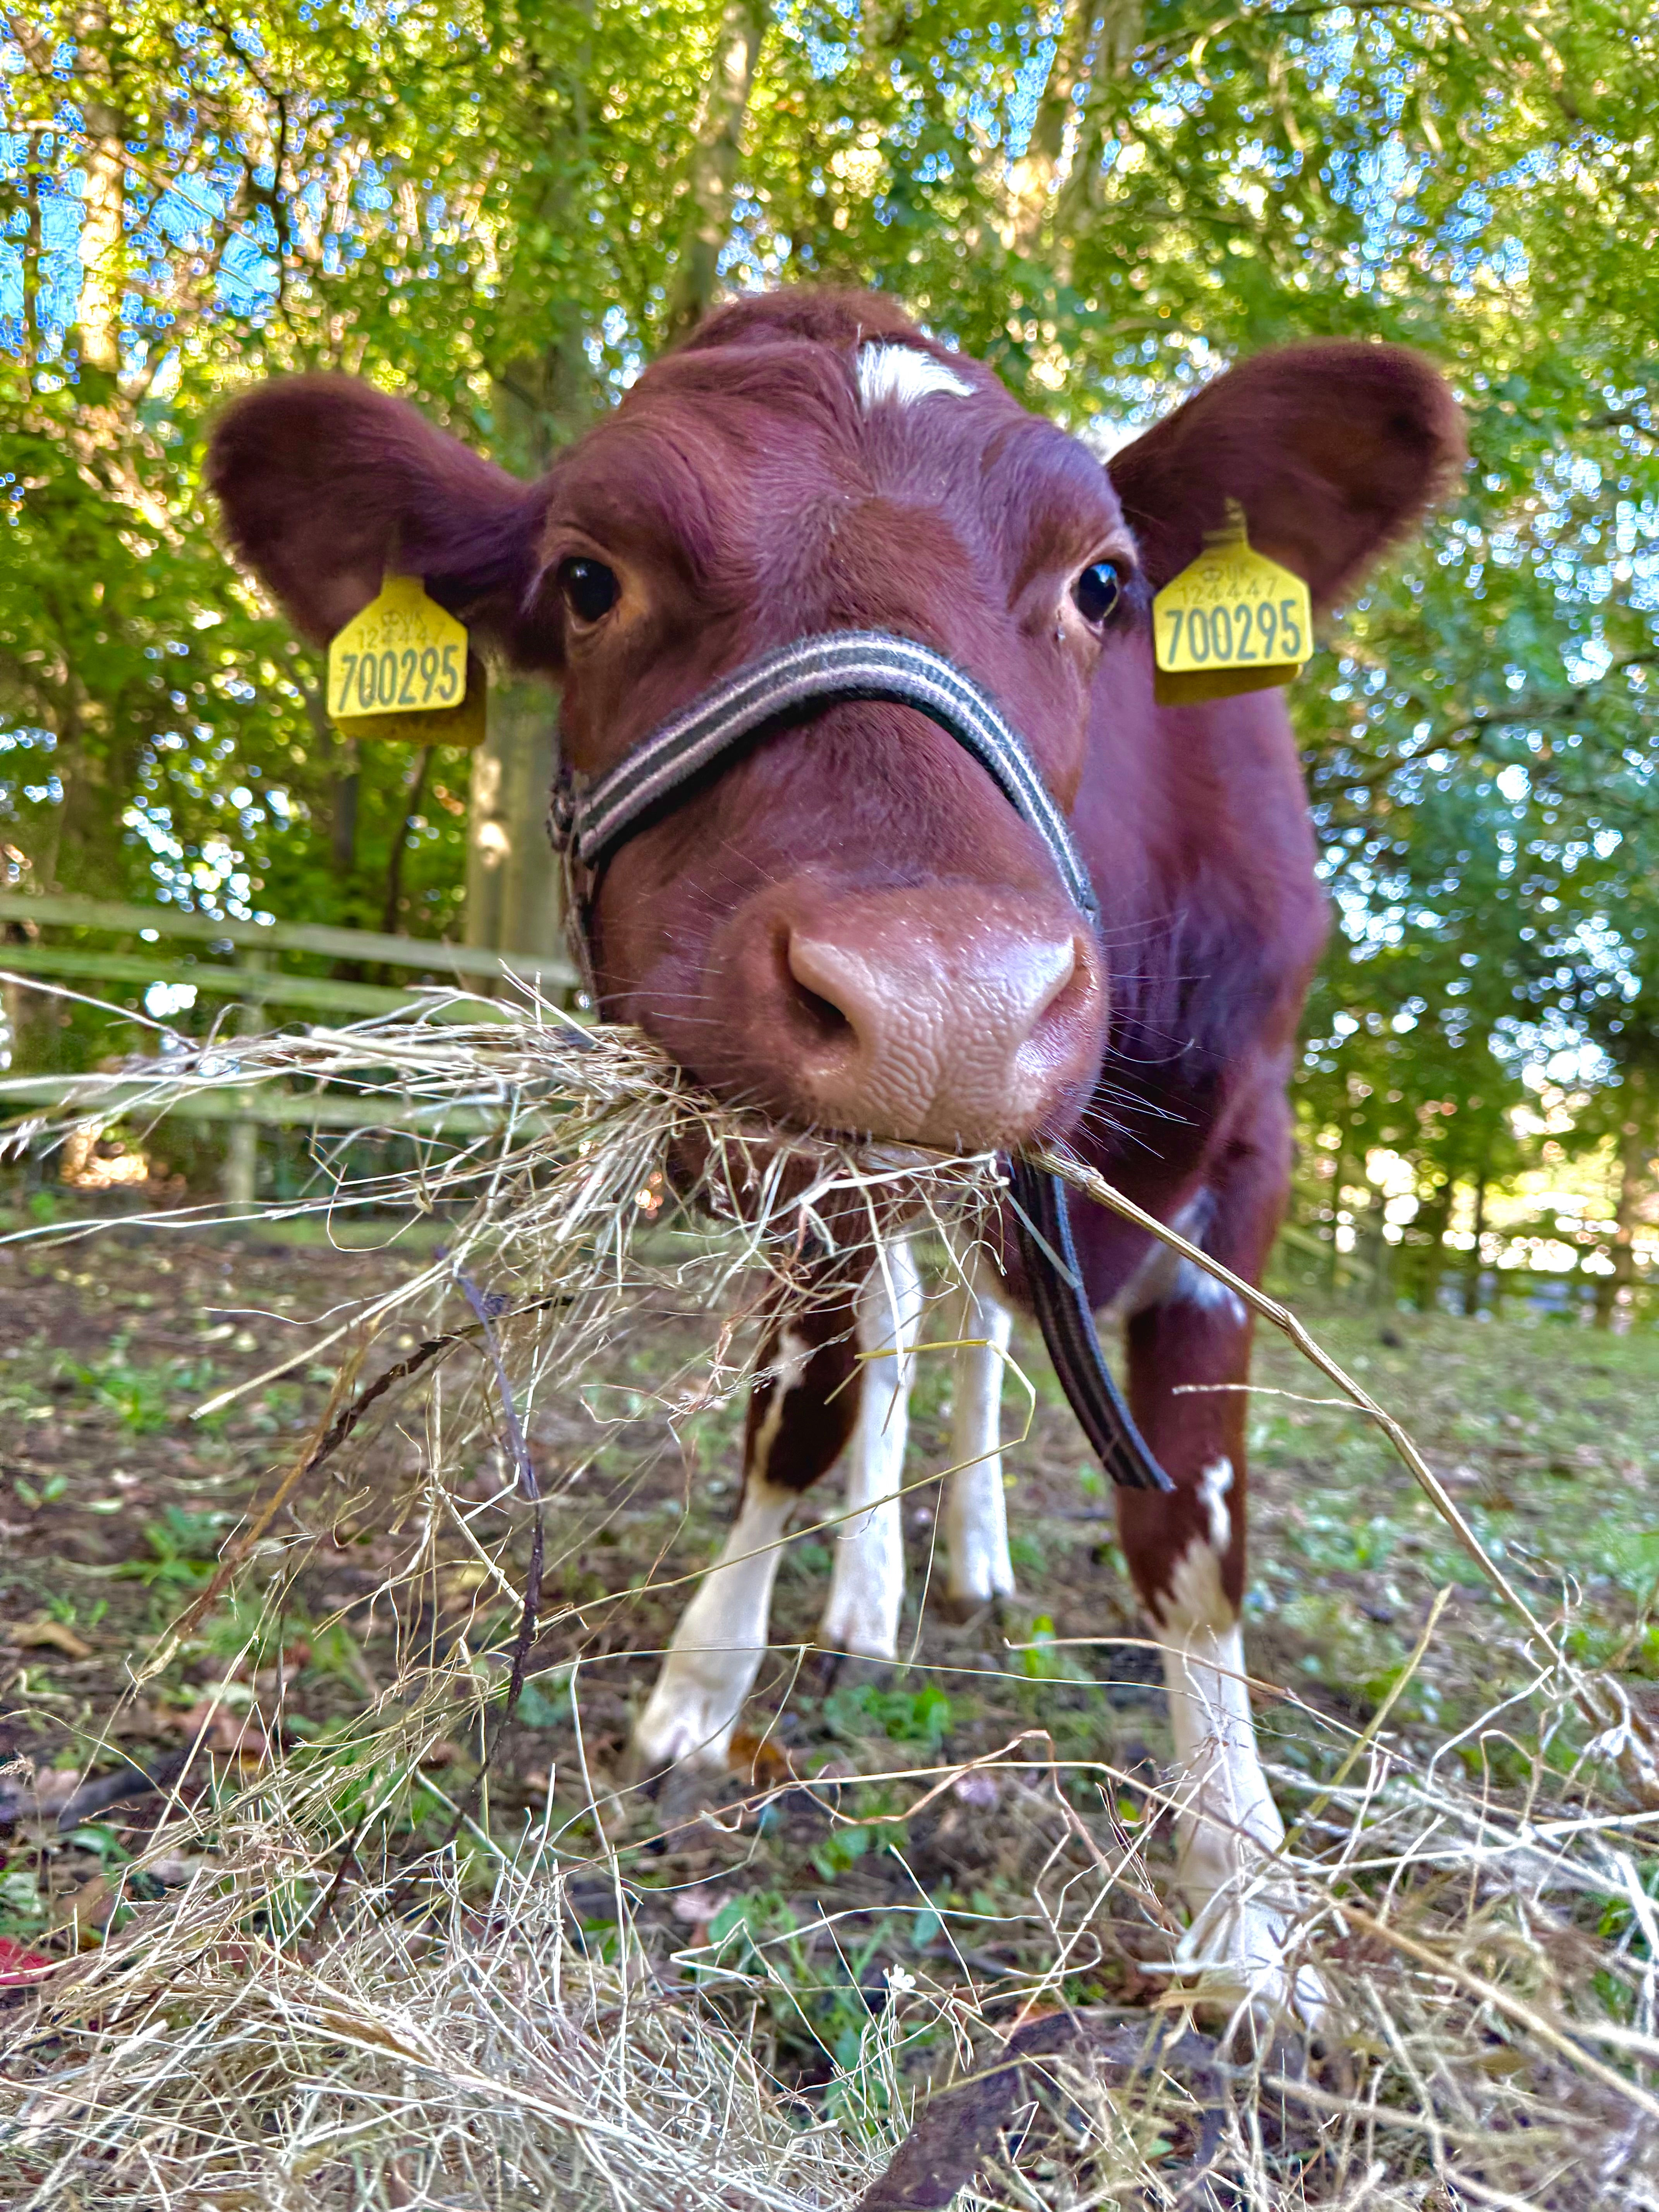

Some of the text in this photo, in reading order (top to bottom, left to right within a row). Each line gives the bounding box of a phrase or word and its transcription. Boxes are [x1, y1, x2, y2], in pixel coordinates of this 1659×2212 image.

[1178, 575, 1278, 605] 124447
[1165, 599, 1301, 665] 700295
[338, 644, 459, 712] 700295
